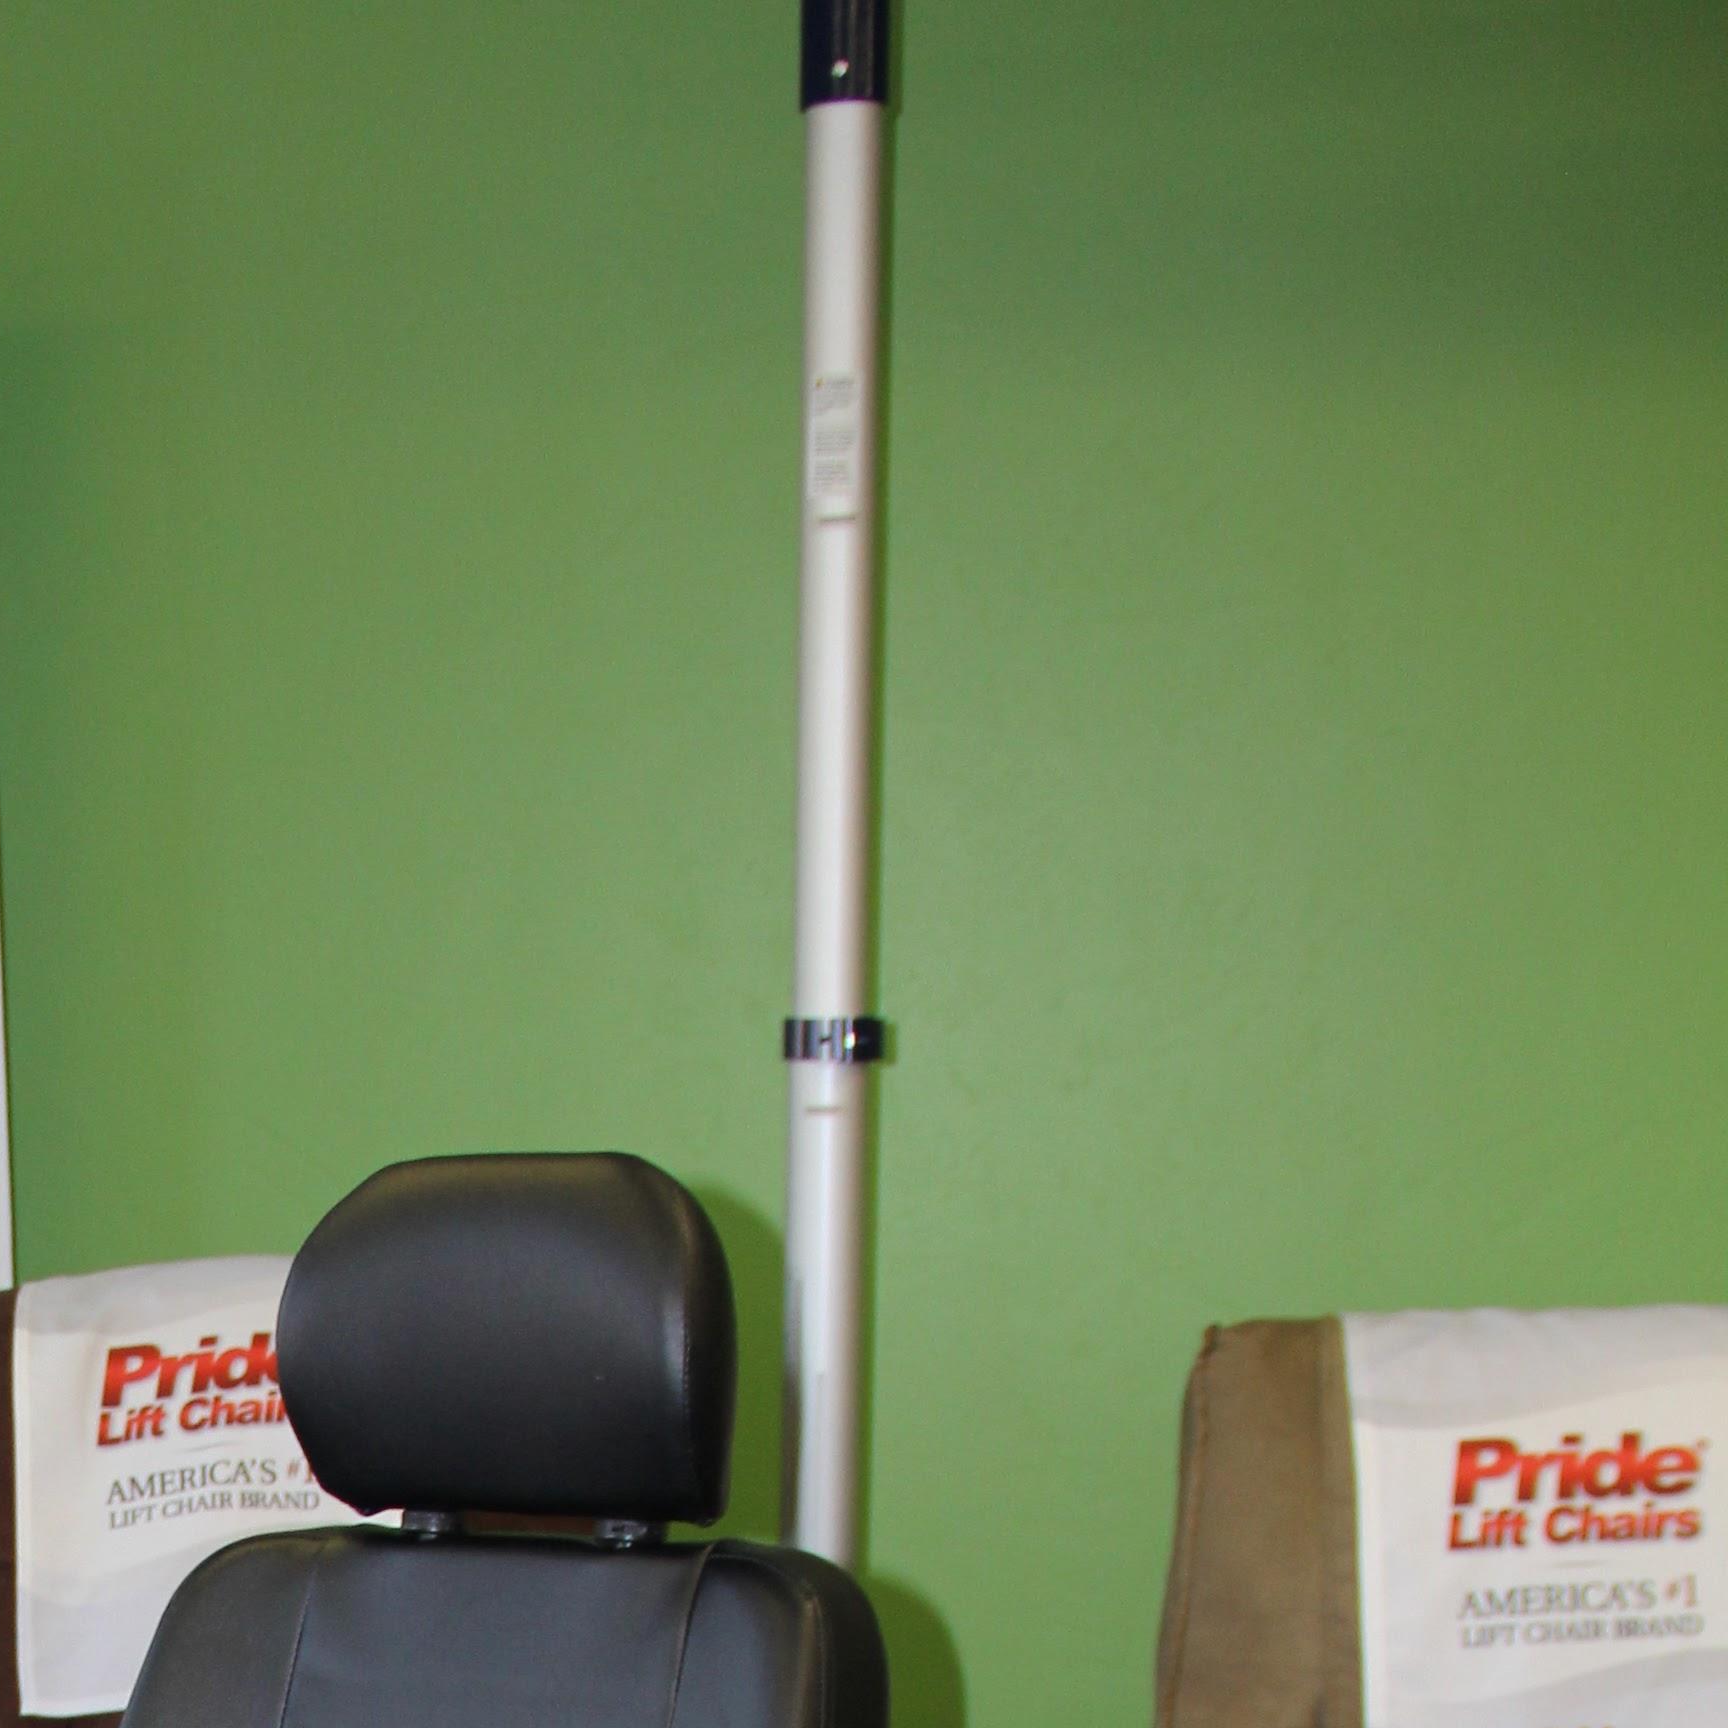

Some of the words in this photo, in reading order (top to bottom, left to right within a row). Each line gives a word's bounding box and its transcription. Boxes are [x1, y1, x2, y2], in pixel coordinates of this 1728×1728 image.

[97, 1405, 168, 1447] Lift
[106, 1458, 277, 1506] AMERICA'S
[1454, 1430, 1700, 1505] Pride
[109, 1506, 155, 1531] LIFT
[161, 1493, 233, 1519] CHAIR
[238, 1490, 320, 1512] BRAND
[1449, 1510, 1526, 1549] Lift
[1544, 1500, 1701, 1544] Chairs
[1458, 1577, 1656, 1619] AMERICA'S
[1462, 1624, 1516, 1649] LIFT
[1523, 1616, 1603, 1644] CHAIR
[1612, 1611, 1704, 1639] BRAND
